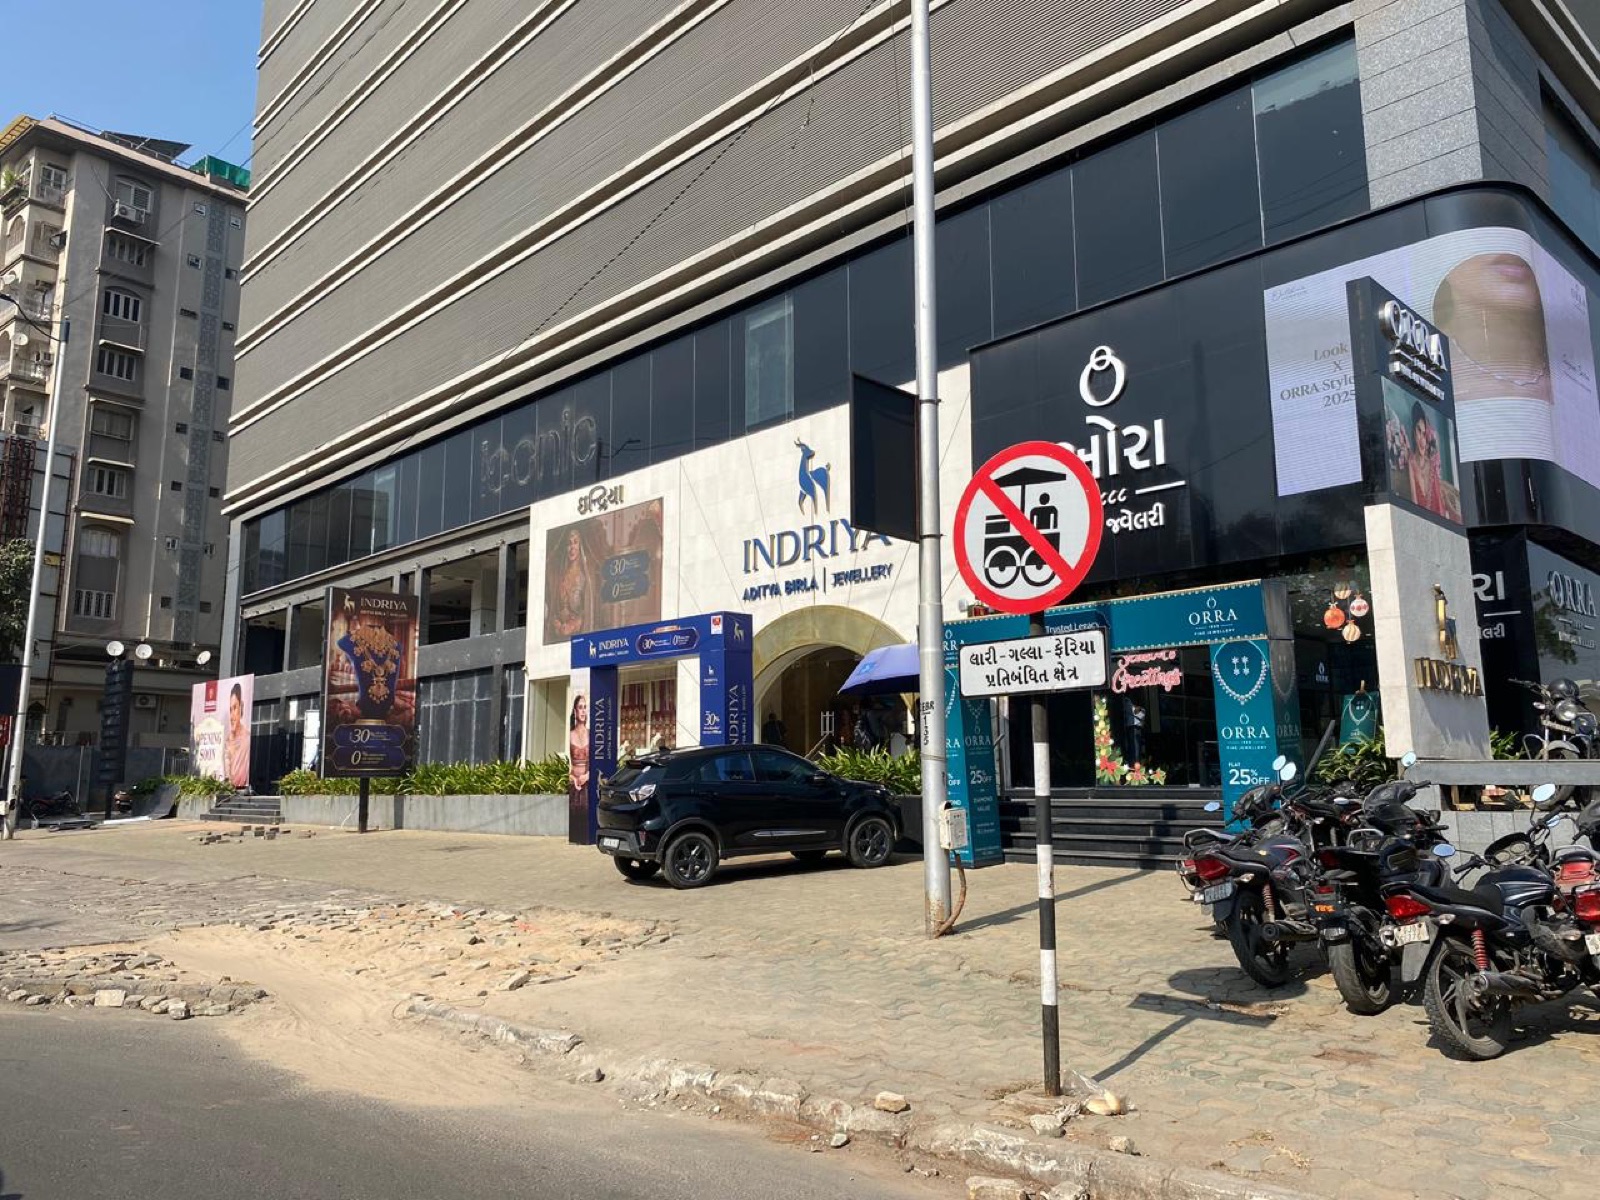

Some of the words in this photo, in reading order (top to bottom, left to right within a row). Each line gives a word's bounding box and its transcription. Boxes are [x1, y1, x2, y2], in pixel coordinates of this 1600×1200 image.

[1379, 299, 1448, 371] ORRA
[1280, 383, 1319, 401] ORRA
[742, 581, 782, 603] ADITYA
[784, 573, 819, 596] BIRLA
[831, 562, 894, 588] JEWELLERY
[1548, 570, 1597, 617] ORRA
[360, 597, 407, 611] INDRIYA
[1188, 608, 1239, 626] ORRA
[599, 637, 629, 651] INDRIYA
[595, 698, 605, 760] INDRIYA
[1221, 725, 1270, 740] ORRA
[965, 736, 992, 747] ORRA
[1251, 777, 1270, 785] OFF
